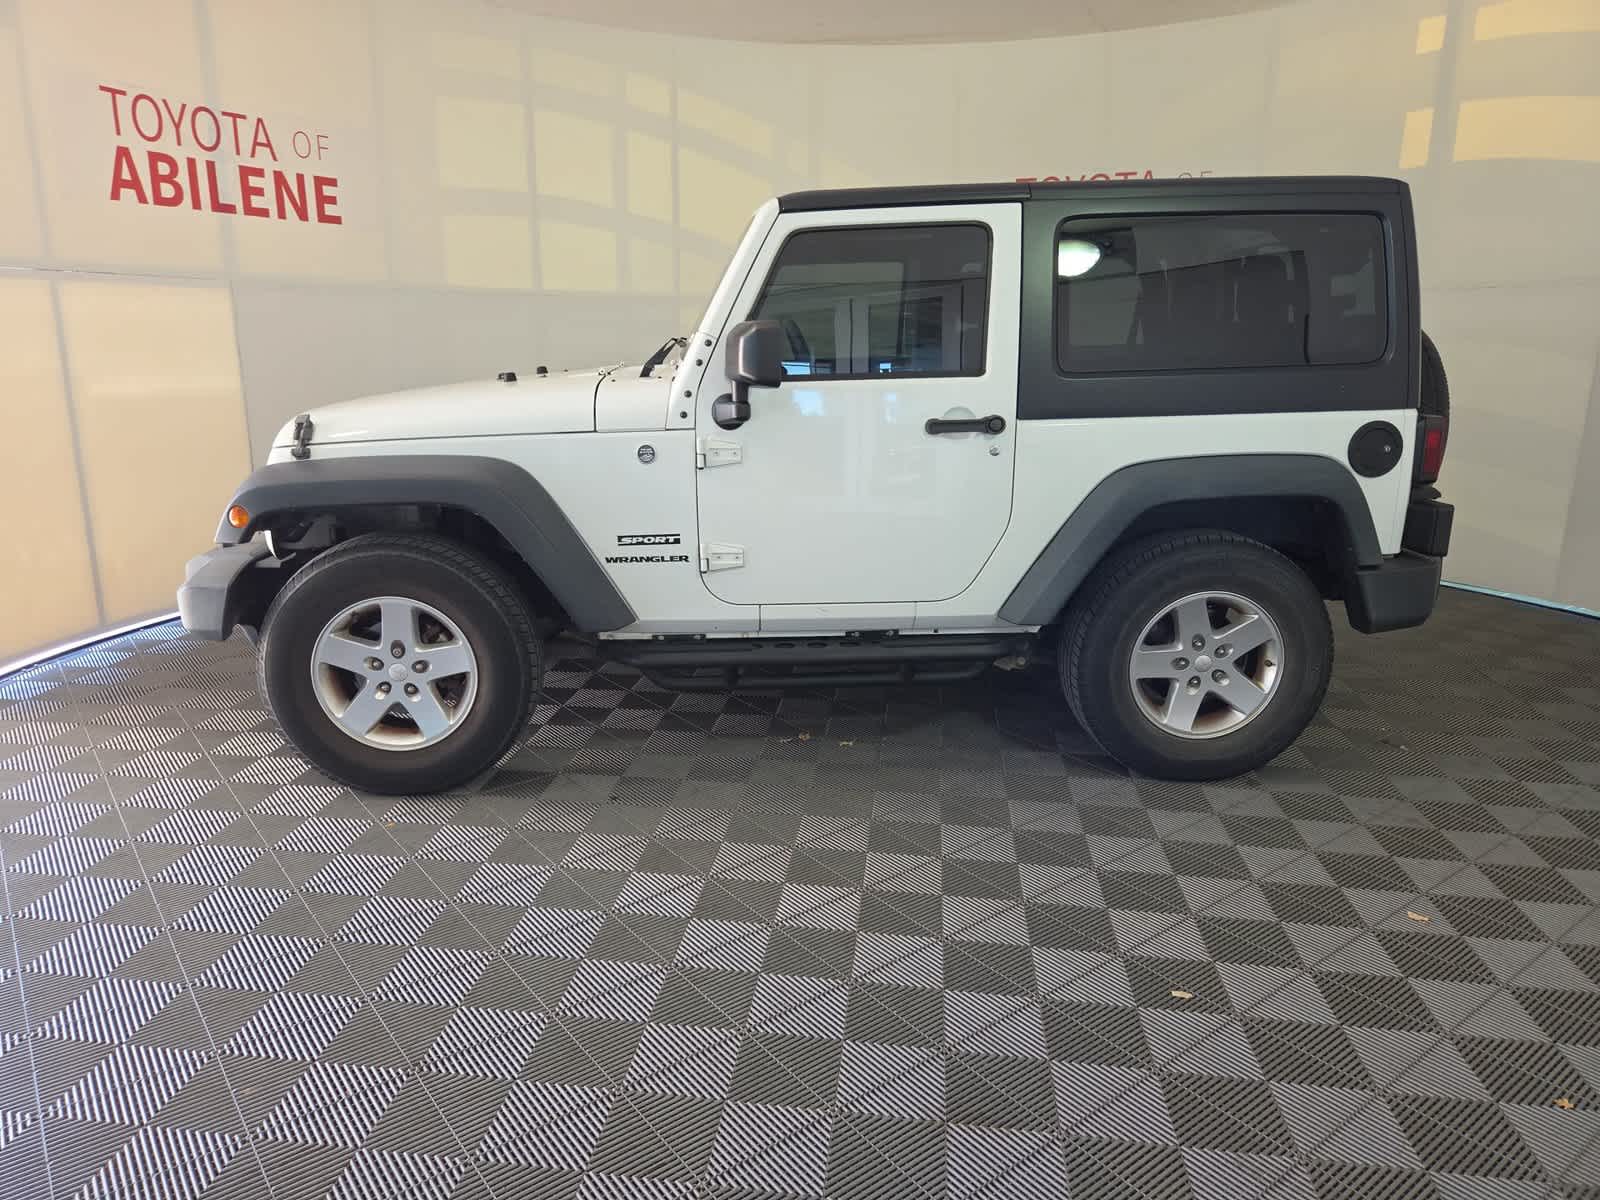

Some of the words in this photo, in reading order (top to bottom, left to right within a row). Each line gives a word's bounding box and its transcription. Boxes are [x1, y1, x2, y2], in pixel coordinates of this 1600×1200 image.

[99, 85, 279, 161] TOYOTA
[293, 131, 329, 160] OF
[110, 145, 342, 225] ABILENE
[605, 555, 690, 564] WRANGLER
[618, 535, 680, 545] SPORT
